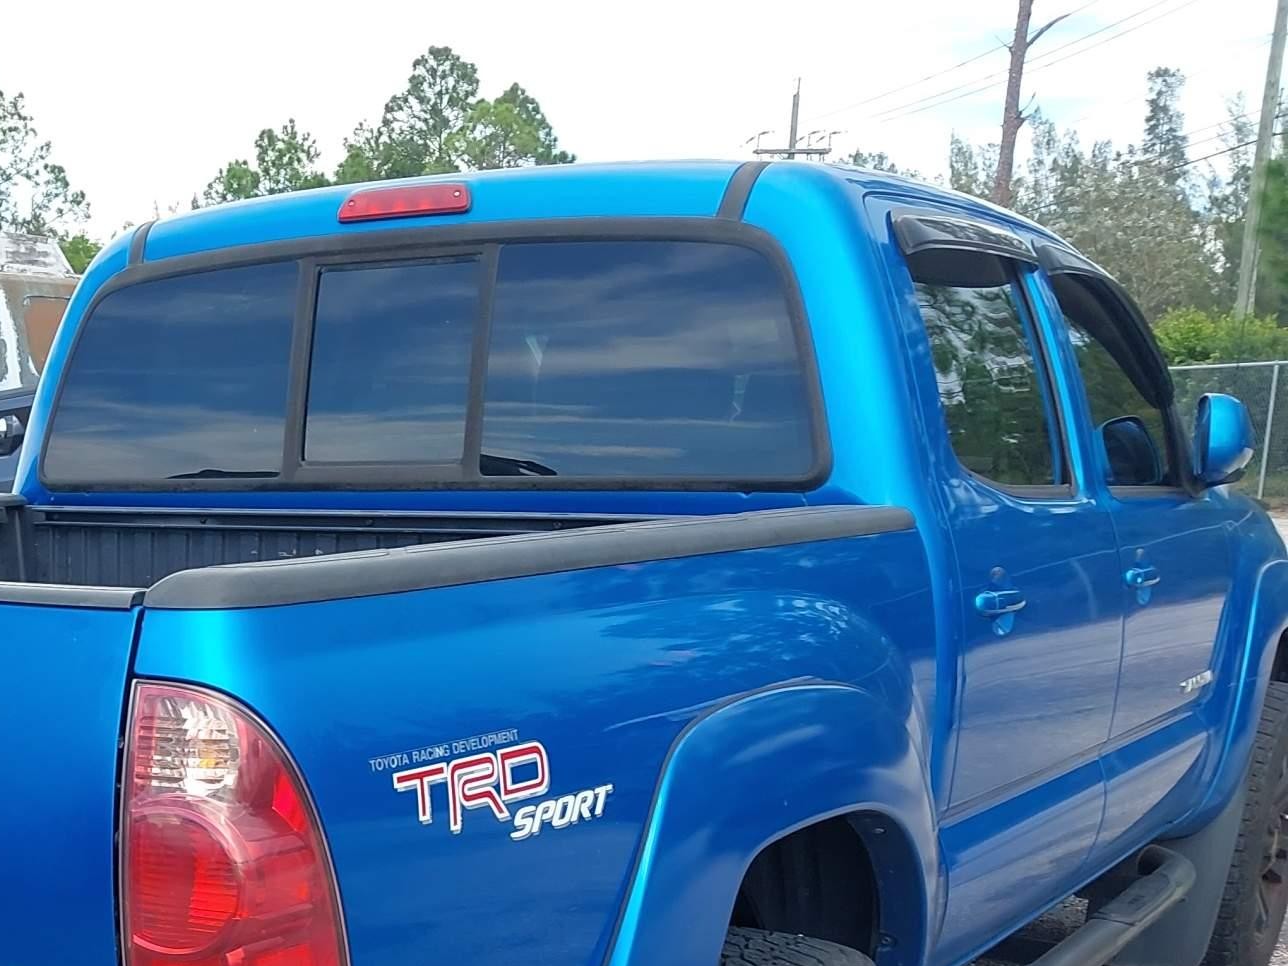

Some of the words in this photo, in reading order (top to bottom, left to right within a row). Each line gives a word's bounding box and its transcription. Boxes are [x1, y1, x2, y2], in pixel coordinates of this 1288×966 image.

[368, 754, 410, 772] TOYOTA
[412, 744, 450, 763] RACING
[452, 728, 519, 754] DEVELOPMENT
[392, 740, 550, 834] TRD
[510, 784, 614, 841] SPORT
